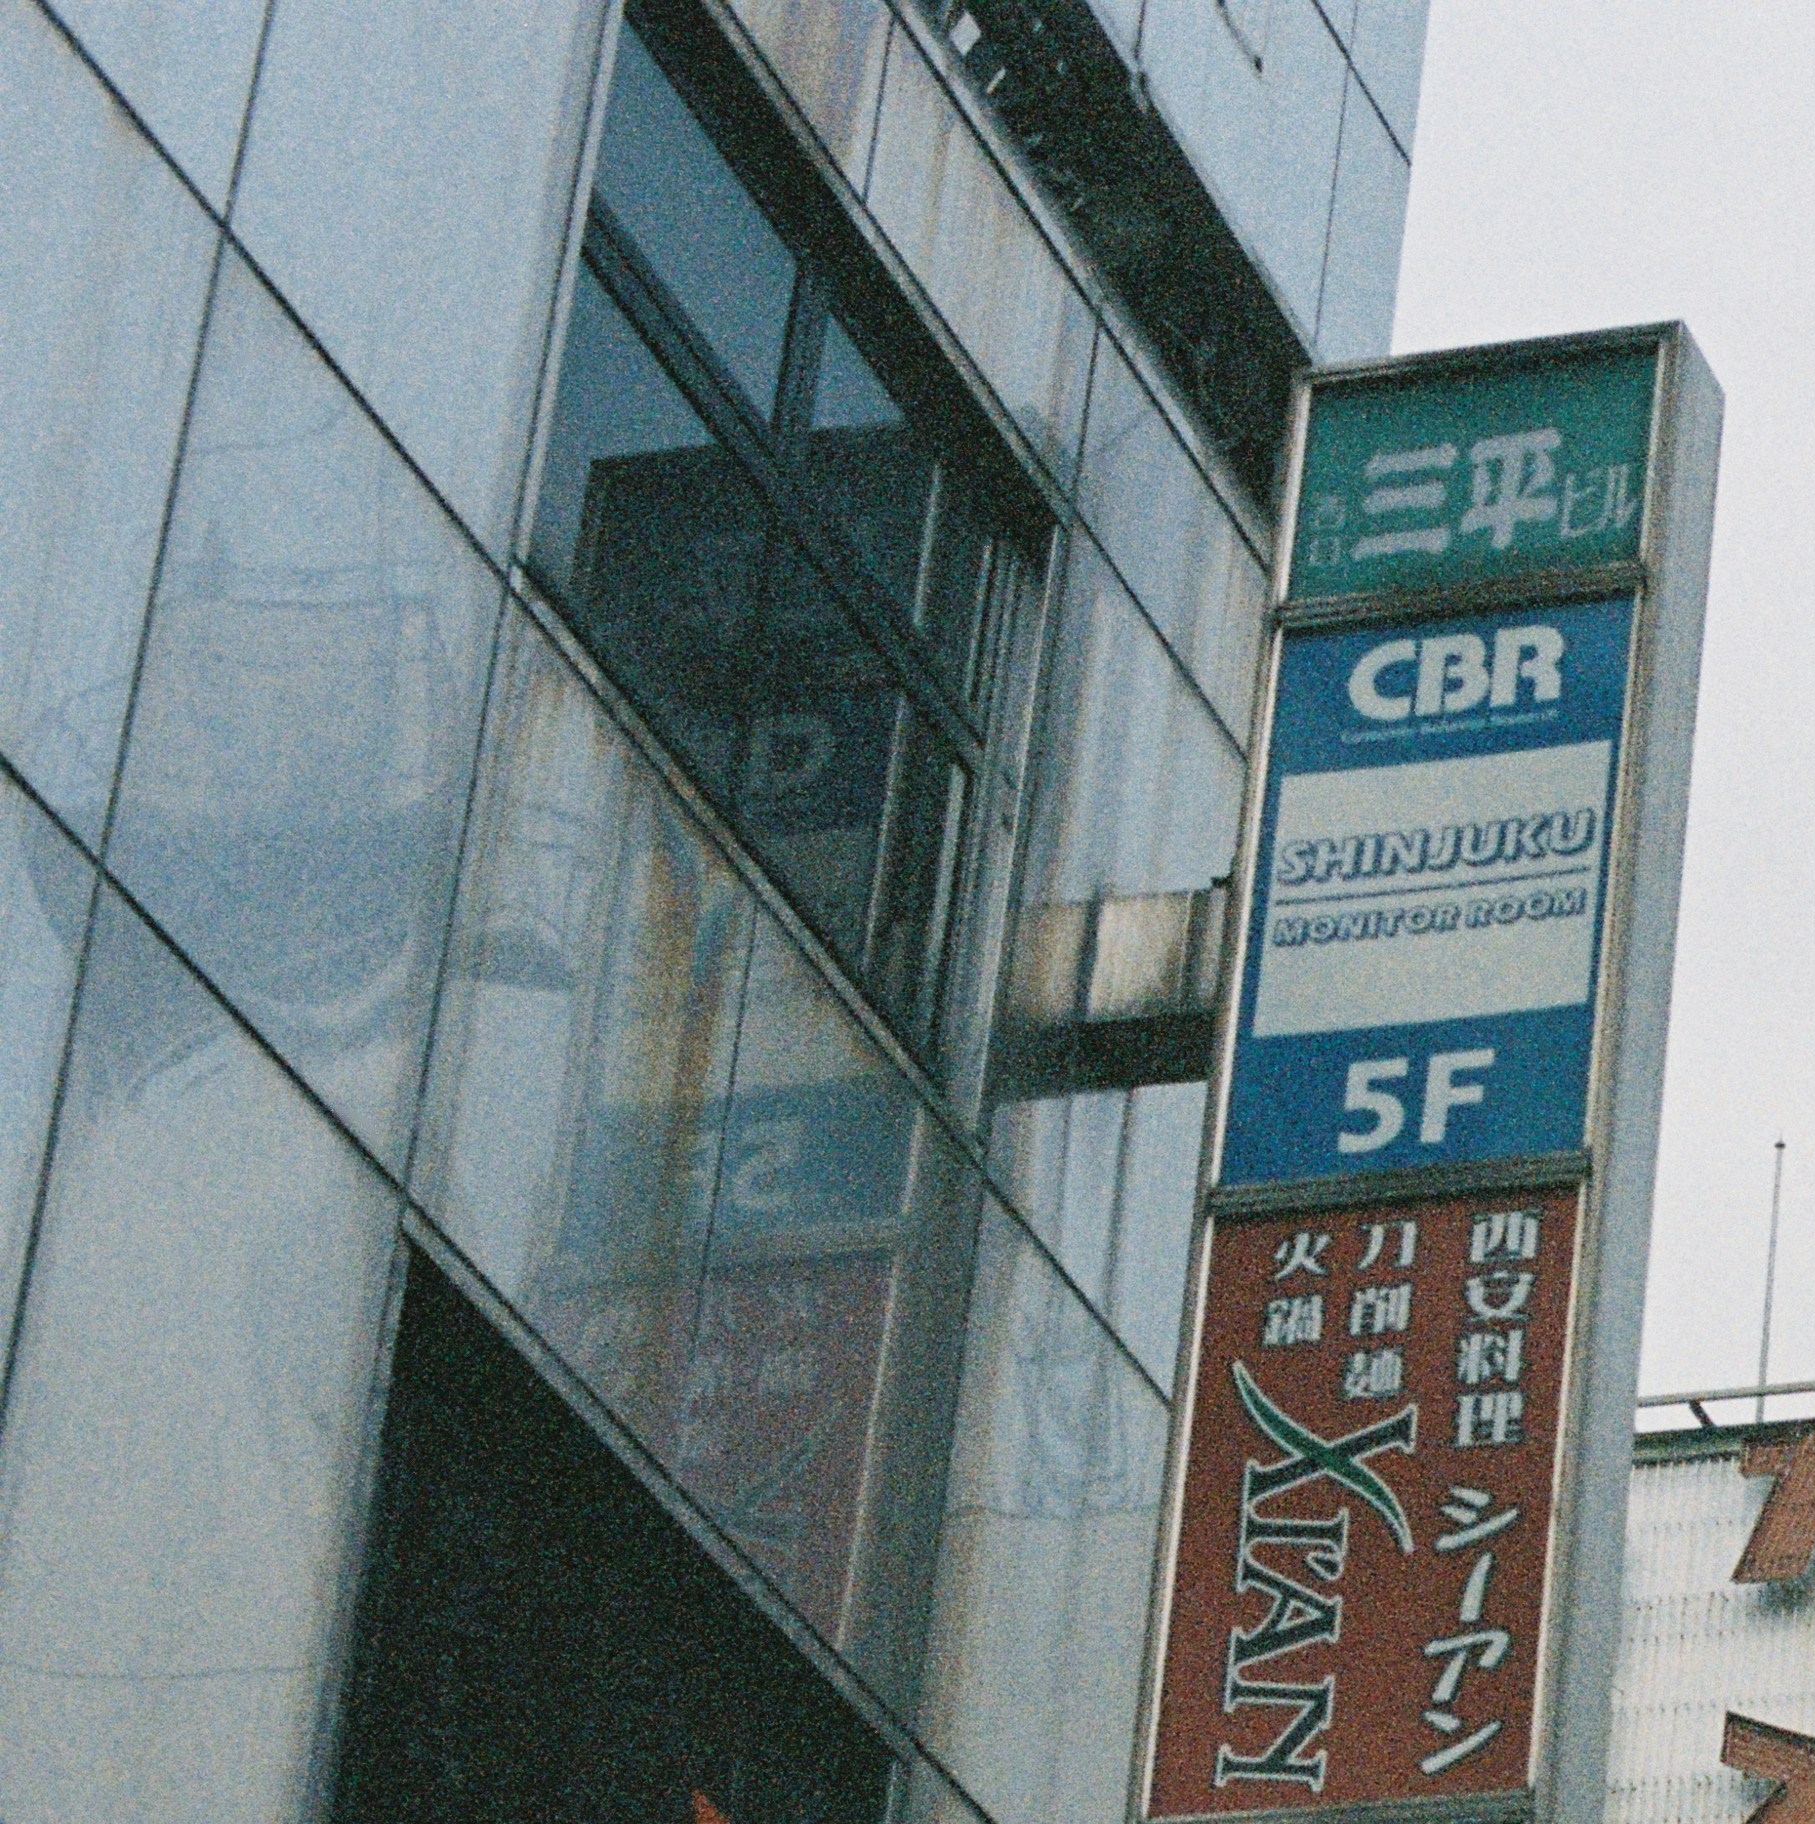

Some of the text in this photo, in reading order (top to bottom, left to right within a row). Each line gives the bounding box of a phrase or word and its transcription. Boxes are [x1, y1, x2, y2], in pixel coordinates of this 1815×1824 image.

[1348, 624, 1565, 722] CBR
[1275, 806, 1598, 886] SHINJUKU
[1463, 886, 1588, 930] ROOM
[1336, 1047, 1495, 1154] 5F
[1419, 1207, 1541, 1775] 西安料理 シーアン
